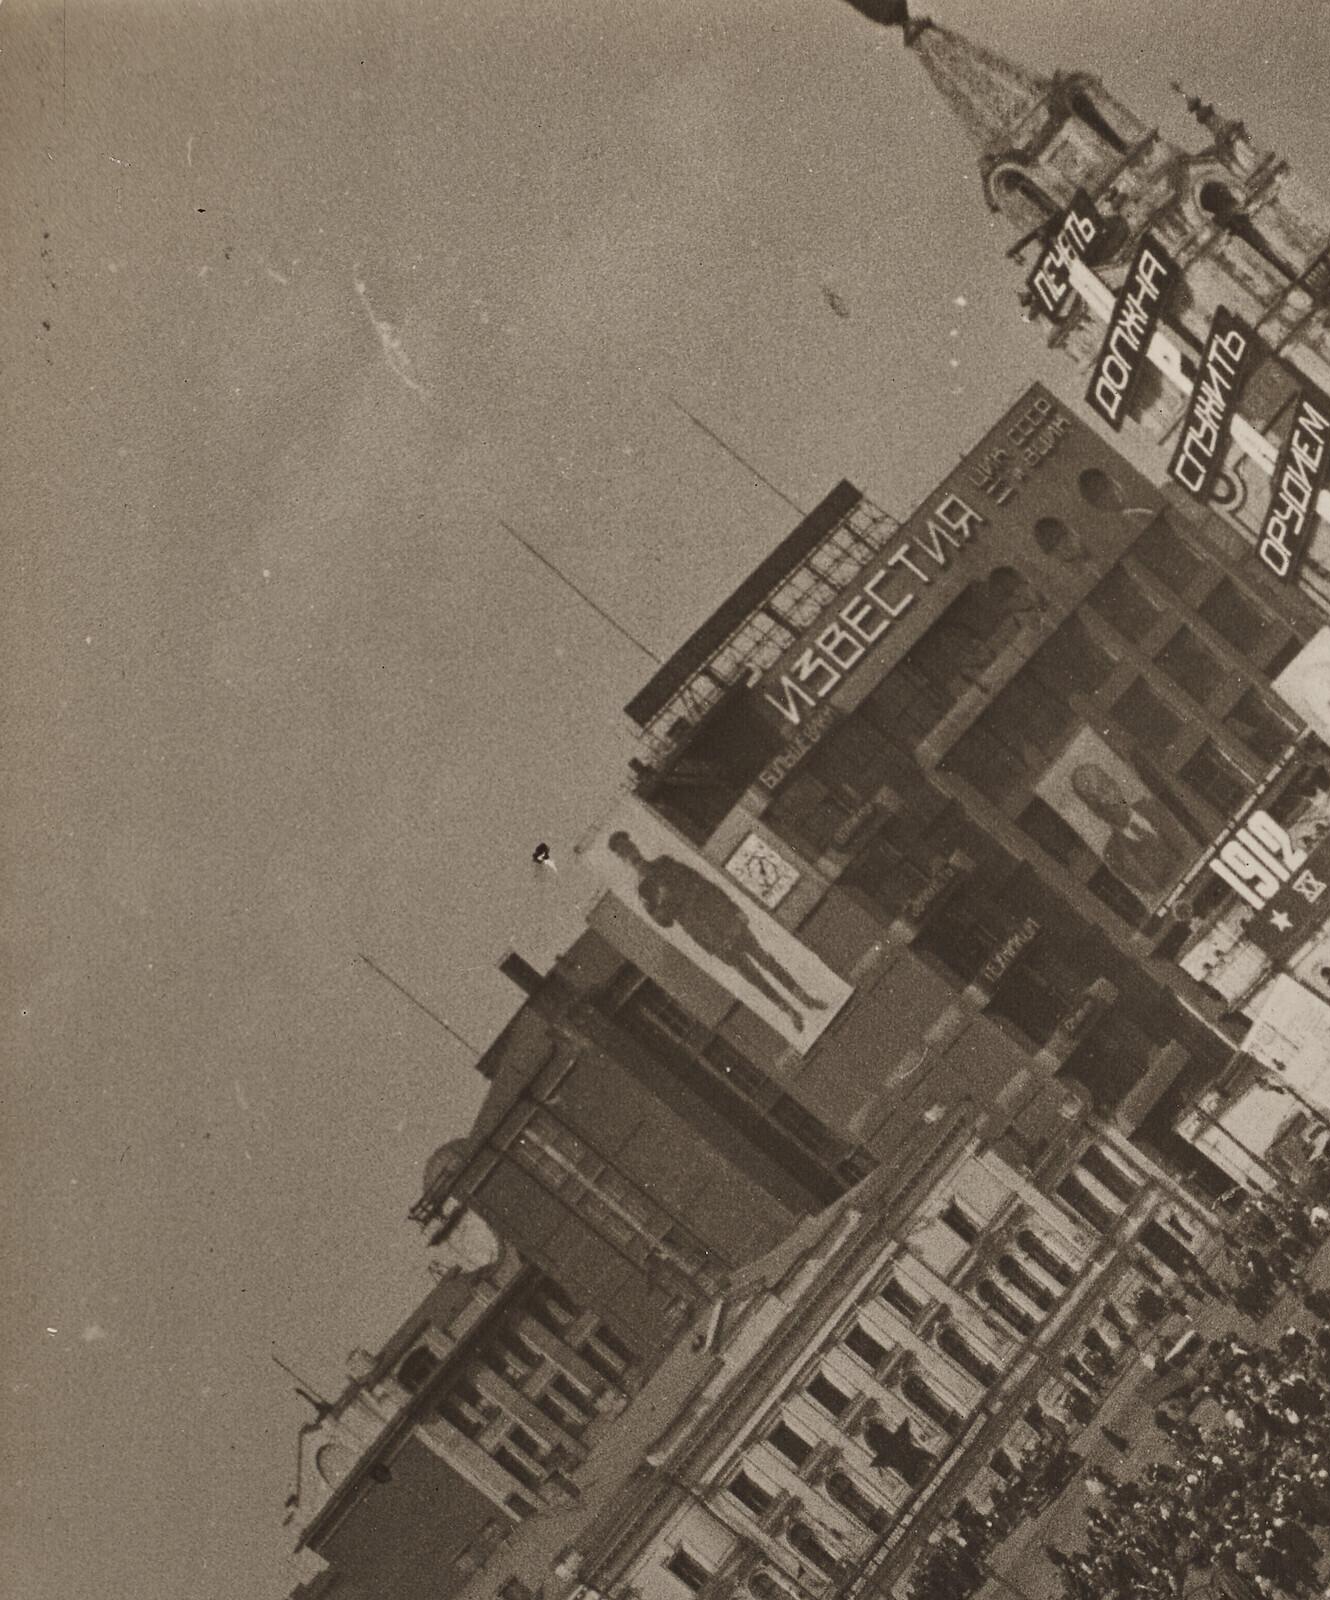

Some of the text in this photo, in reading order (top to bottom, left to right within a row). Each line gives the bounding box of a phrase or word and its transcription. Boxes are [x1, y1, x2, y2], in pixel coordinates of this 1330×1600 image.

[1034, 209, 1097, 314] ПЕЧАТЬ
[1096, 249, 1167, 420] ДОЛЖНА
[1174, 330, 1247, 493] СЛУЖИТЬ
[764, 492, 985, 726] ИЗВЕСТИЯ
[1208, 809, 1306, 911] 1912
